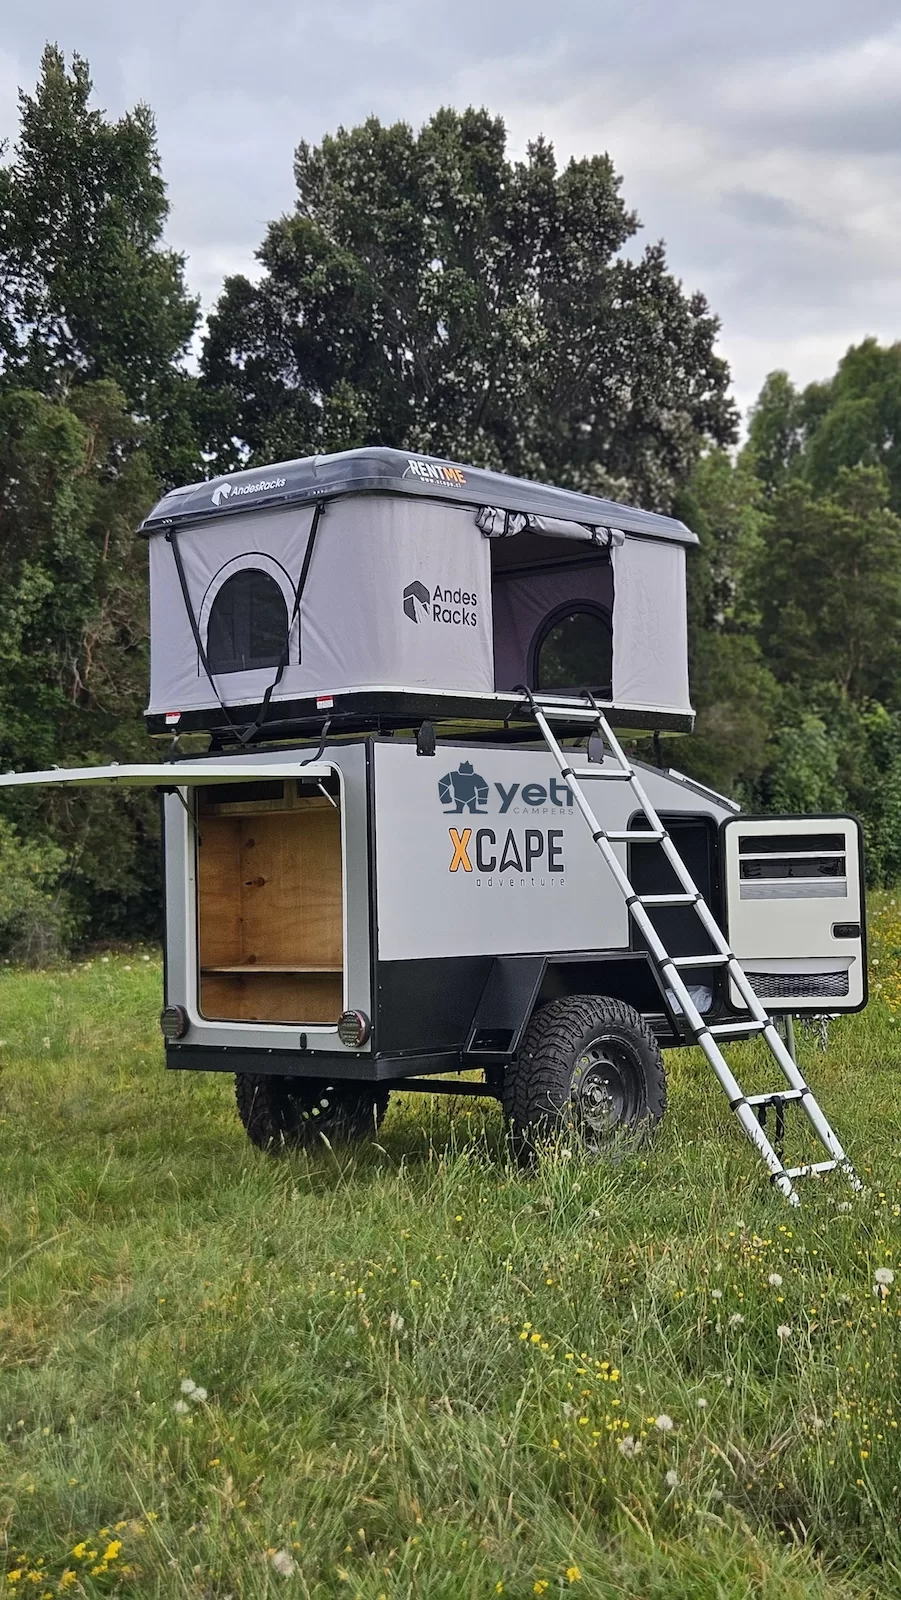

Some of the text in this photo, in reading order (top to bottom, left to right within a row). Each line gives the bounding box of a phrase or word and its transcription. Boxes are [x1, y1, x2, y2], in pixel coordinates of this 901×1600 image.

[432, 585, 477, 606] Andes
[432, 604, 477, 626] Racks
[513, 807, 574, 816] CAMPERS
[448, 828, 565, 873] XCAPE
[476, 877, 566, 887] adventure
